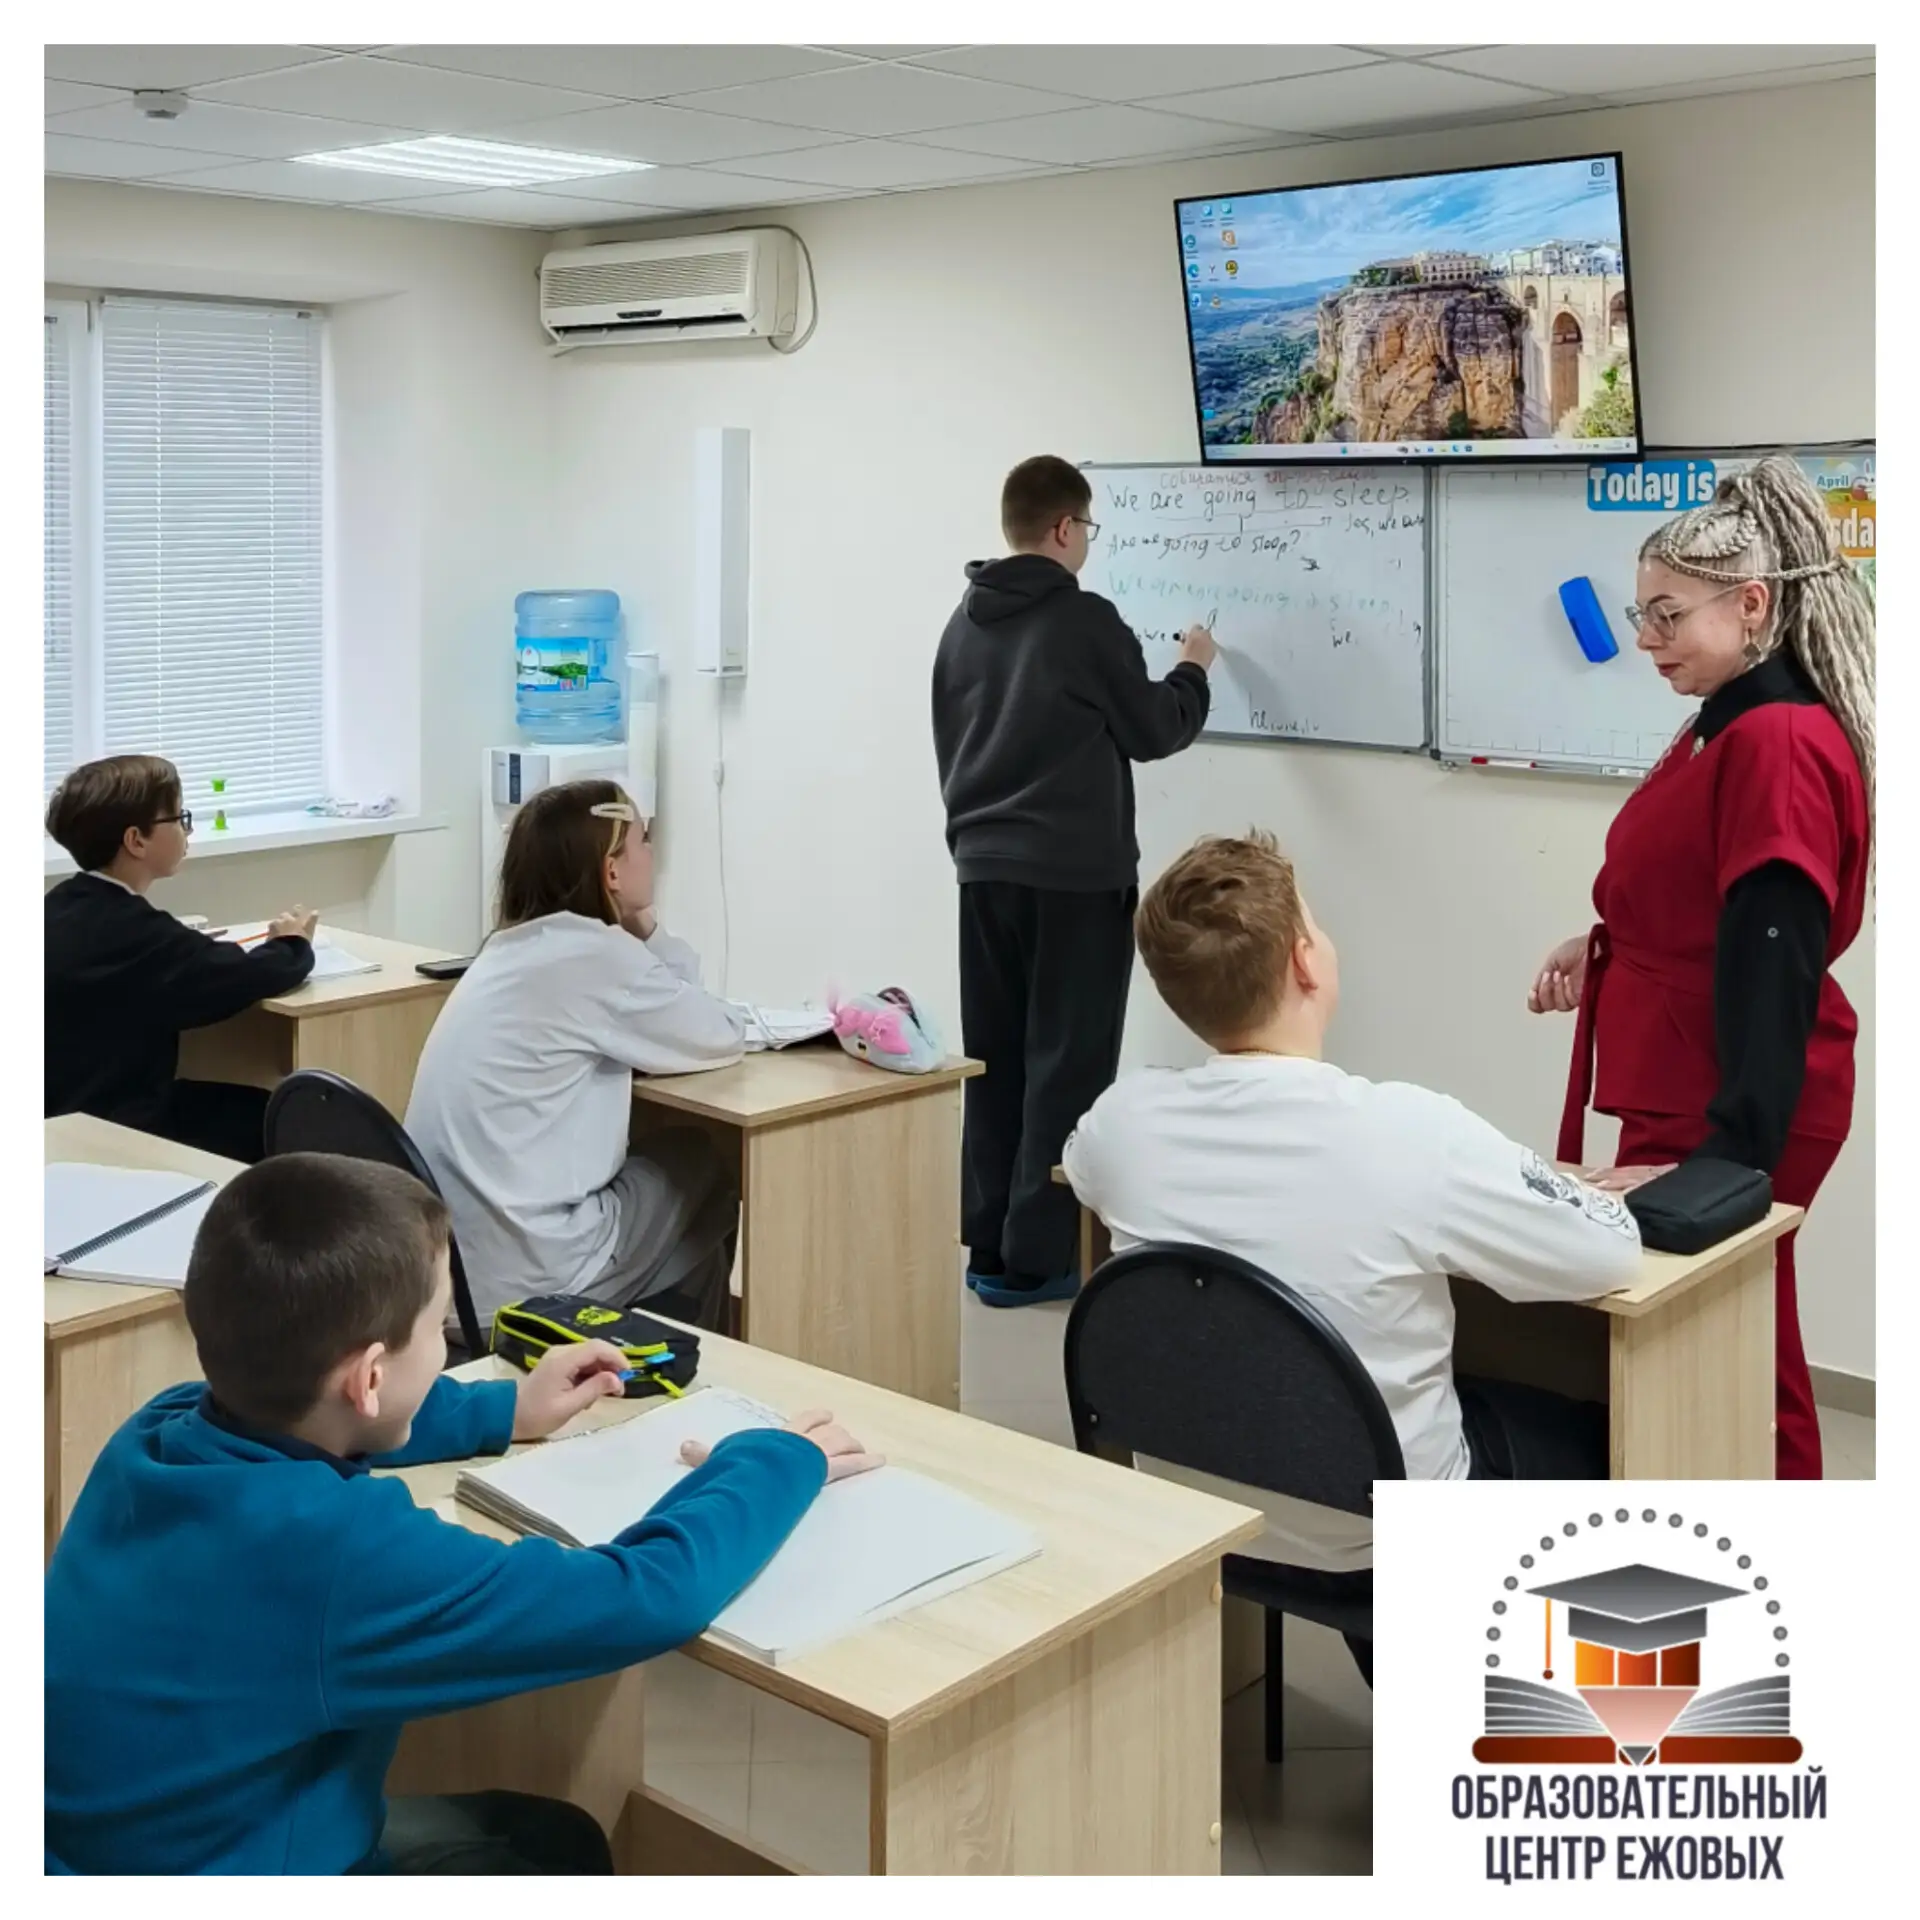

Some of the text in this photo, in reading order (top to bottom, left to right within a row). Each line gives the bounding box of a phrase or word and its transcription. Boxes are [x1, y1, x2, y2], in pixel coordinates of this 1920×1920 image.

[1590, 462, 1714, 509] Today is
[1816, 474, 1849, 489] April
[1106, 483, 1140, 512] We
[1151, 491, 1184, 511] are
[1203, 488, 1257, 522] going
[1157, 536, 1209, 560] going
